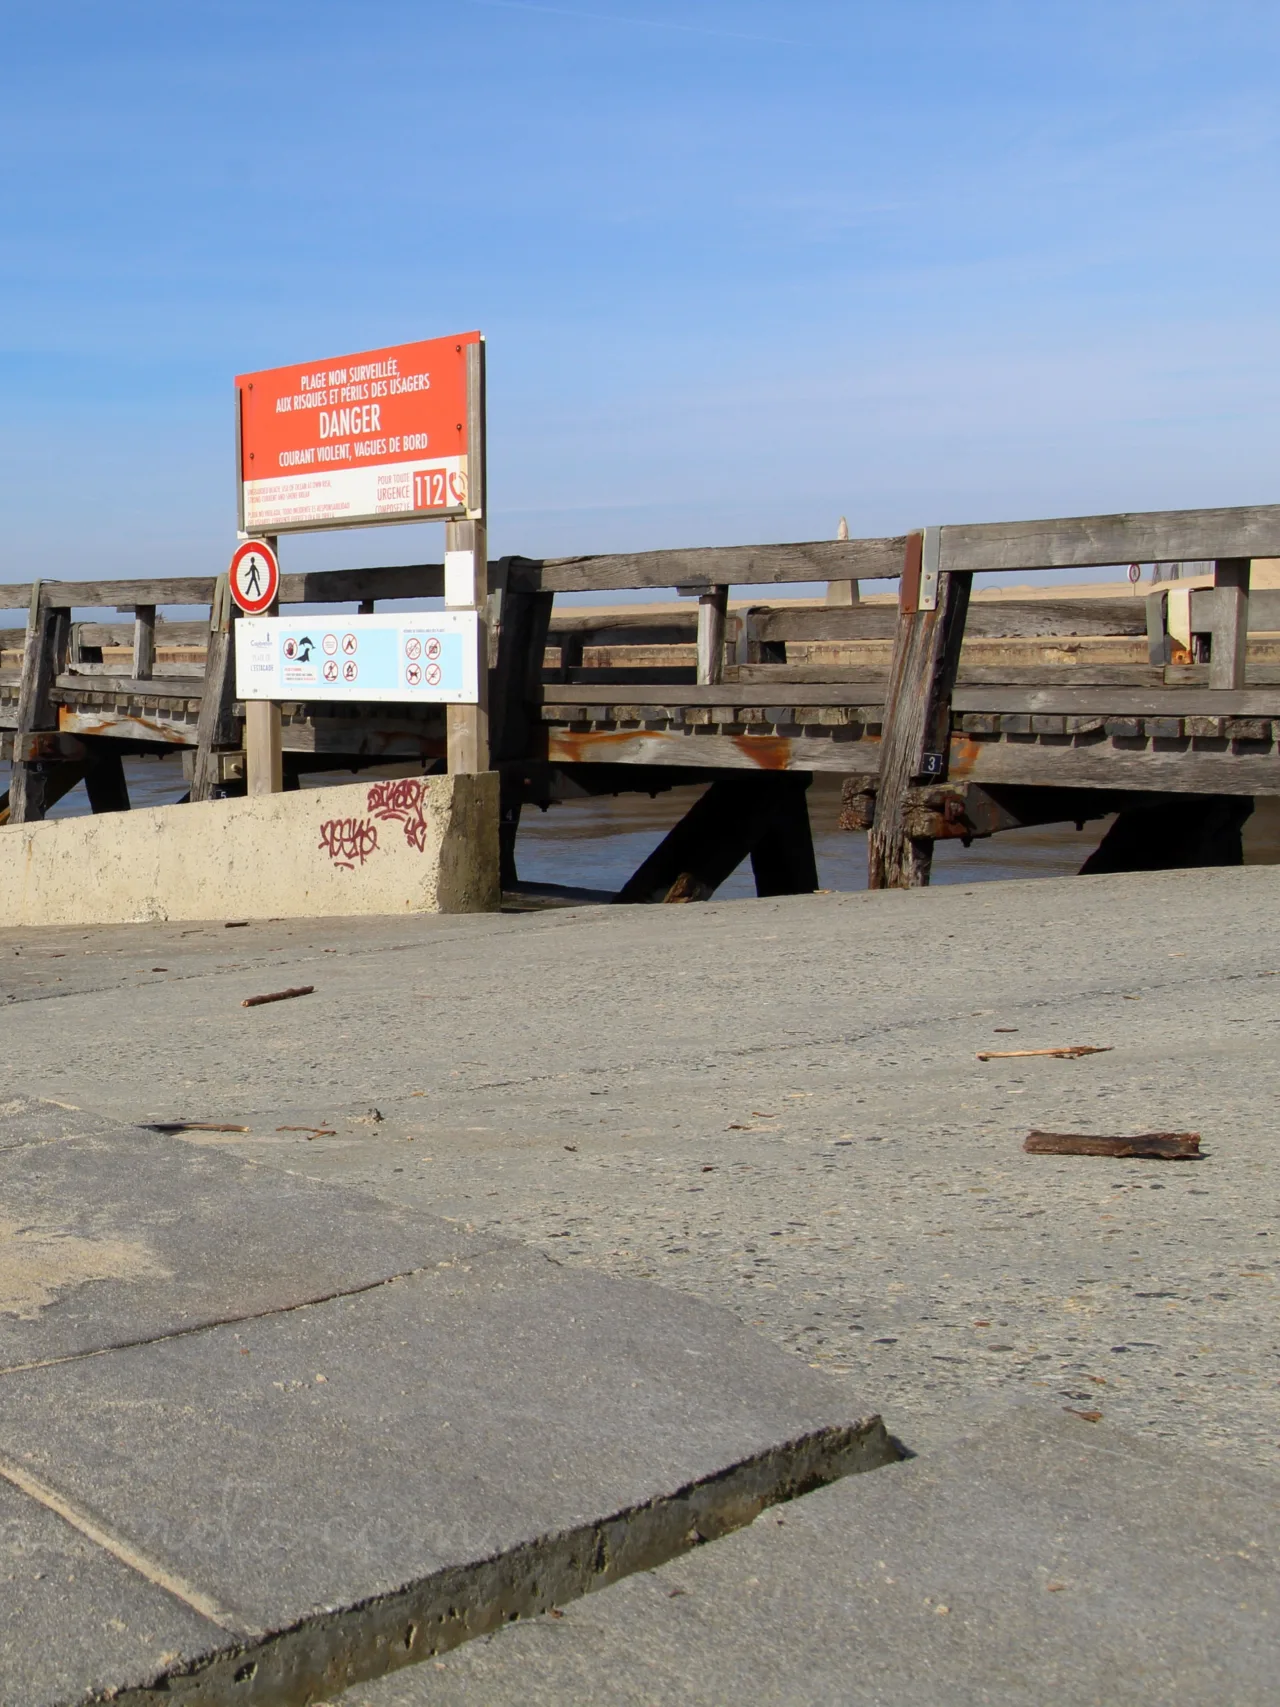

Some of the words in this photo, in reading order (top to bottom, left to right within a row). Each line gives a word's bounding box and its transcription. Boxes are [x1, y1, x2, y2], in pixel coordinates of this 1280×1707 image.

[300, 372, 326, 391] PLAGE
[328, 368, 347, 387] NON
[349, 357, 400, 383] SURVEILLÉE,
[276, 396, 292, 413] AUX
[293, 390, 327, 411] RISQUES
[329, 388, 339, 405] ET
[341, 382, 369, 403] PÉRILS
[371, 380, 388, 399] DES
[389, 373, 430, 395] USAGERS
[319, 403, 381, 439] DANGER
[278, 448, 315, 467] COURANT
[317, 443, 352, 462] VIOLENT,
[354, 438, 387, 457] VAGUES
[389, 436, 400, 453] DE
[403, 433, 428, 451] BORD
[377, 475, 392, 485] POUR
[393, 472, 410, 484] TOUTE
[377, 485, 410, 501] URGENCE
[415, 474, 444, 507] 112
[927, 756, 936, 772] 3
